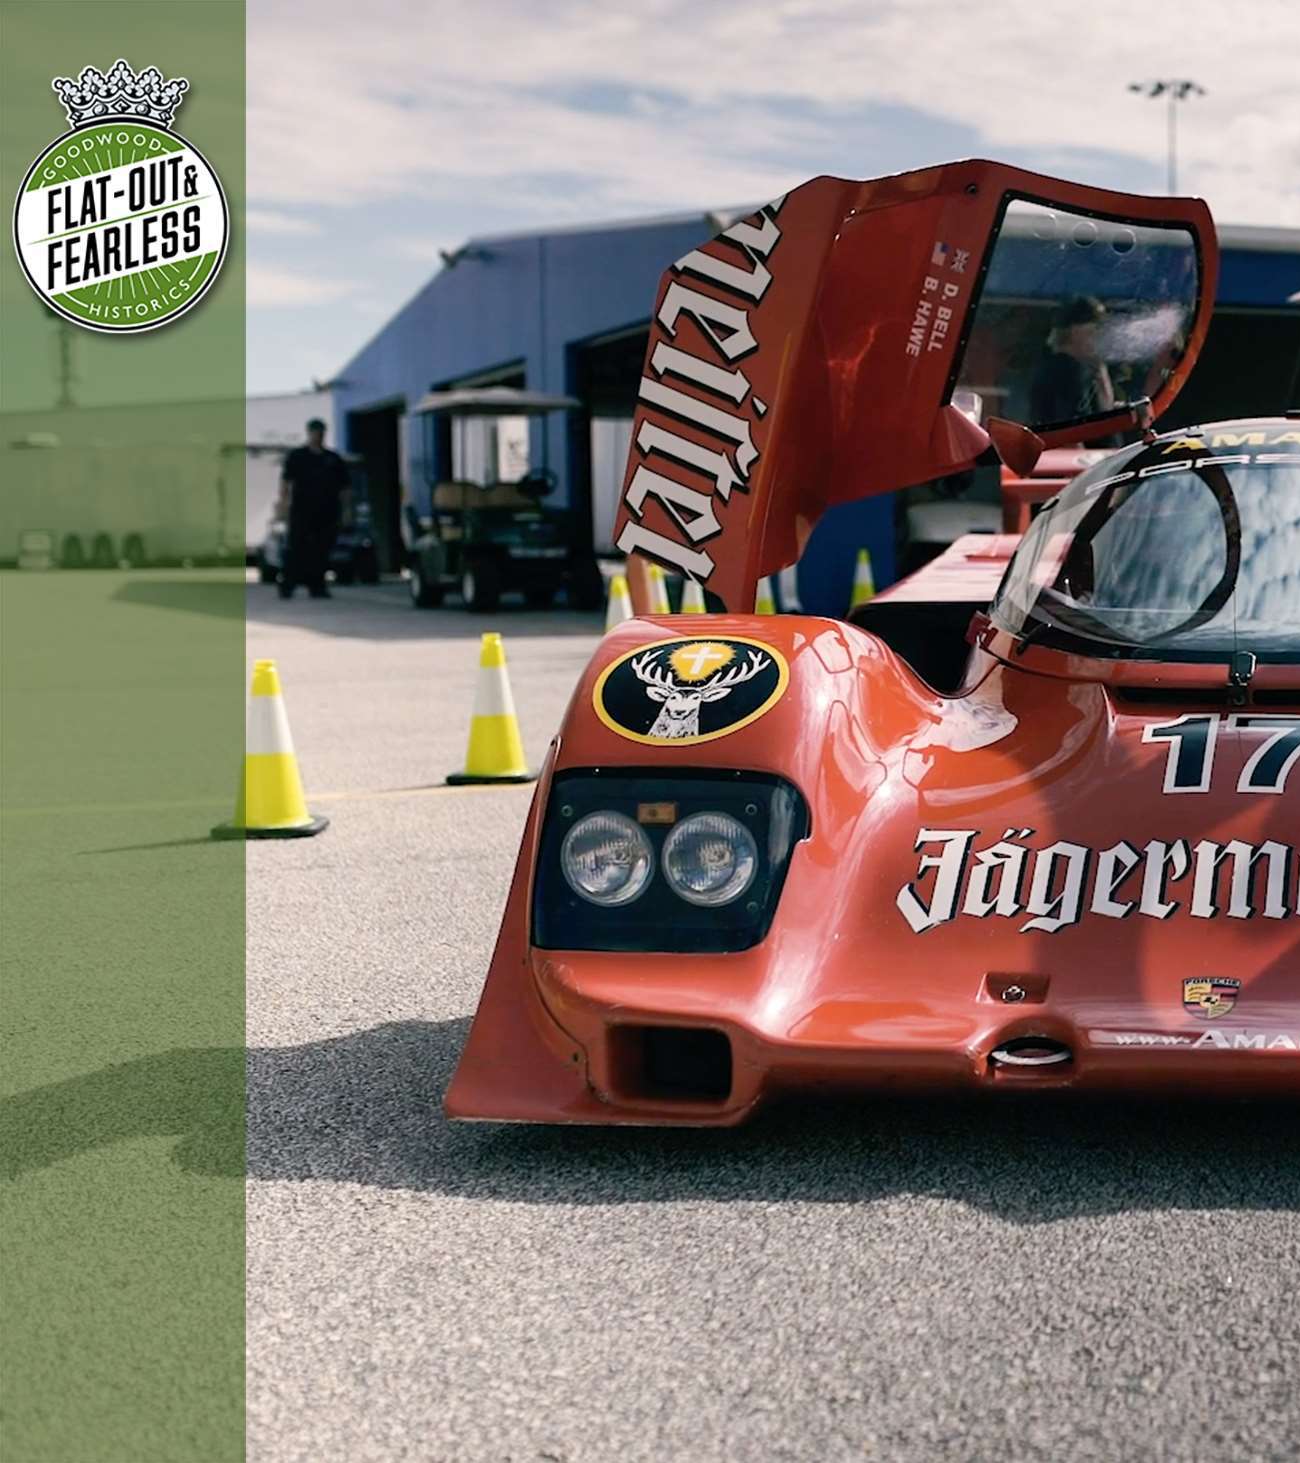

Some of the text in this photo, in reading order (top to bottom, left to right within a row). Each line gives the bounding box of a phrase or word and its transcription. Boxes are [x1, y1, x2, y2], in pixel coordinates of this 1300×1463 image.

[905, 276, 940, 357] B. HAWE
[927, 282, 959, 352] D. BELL
